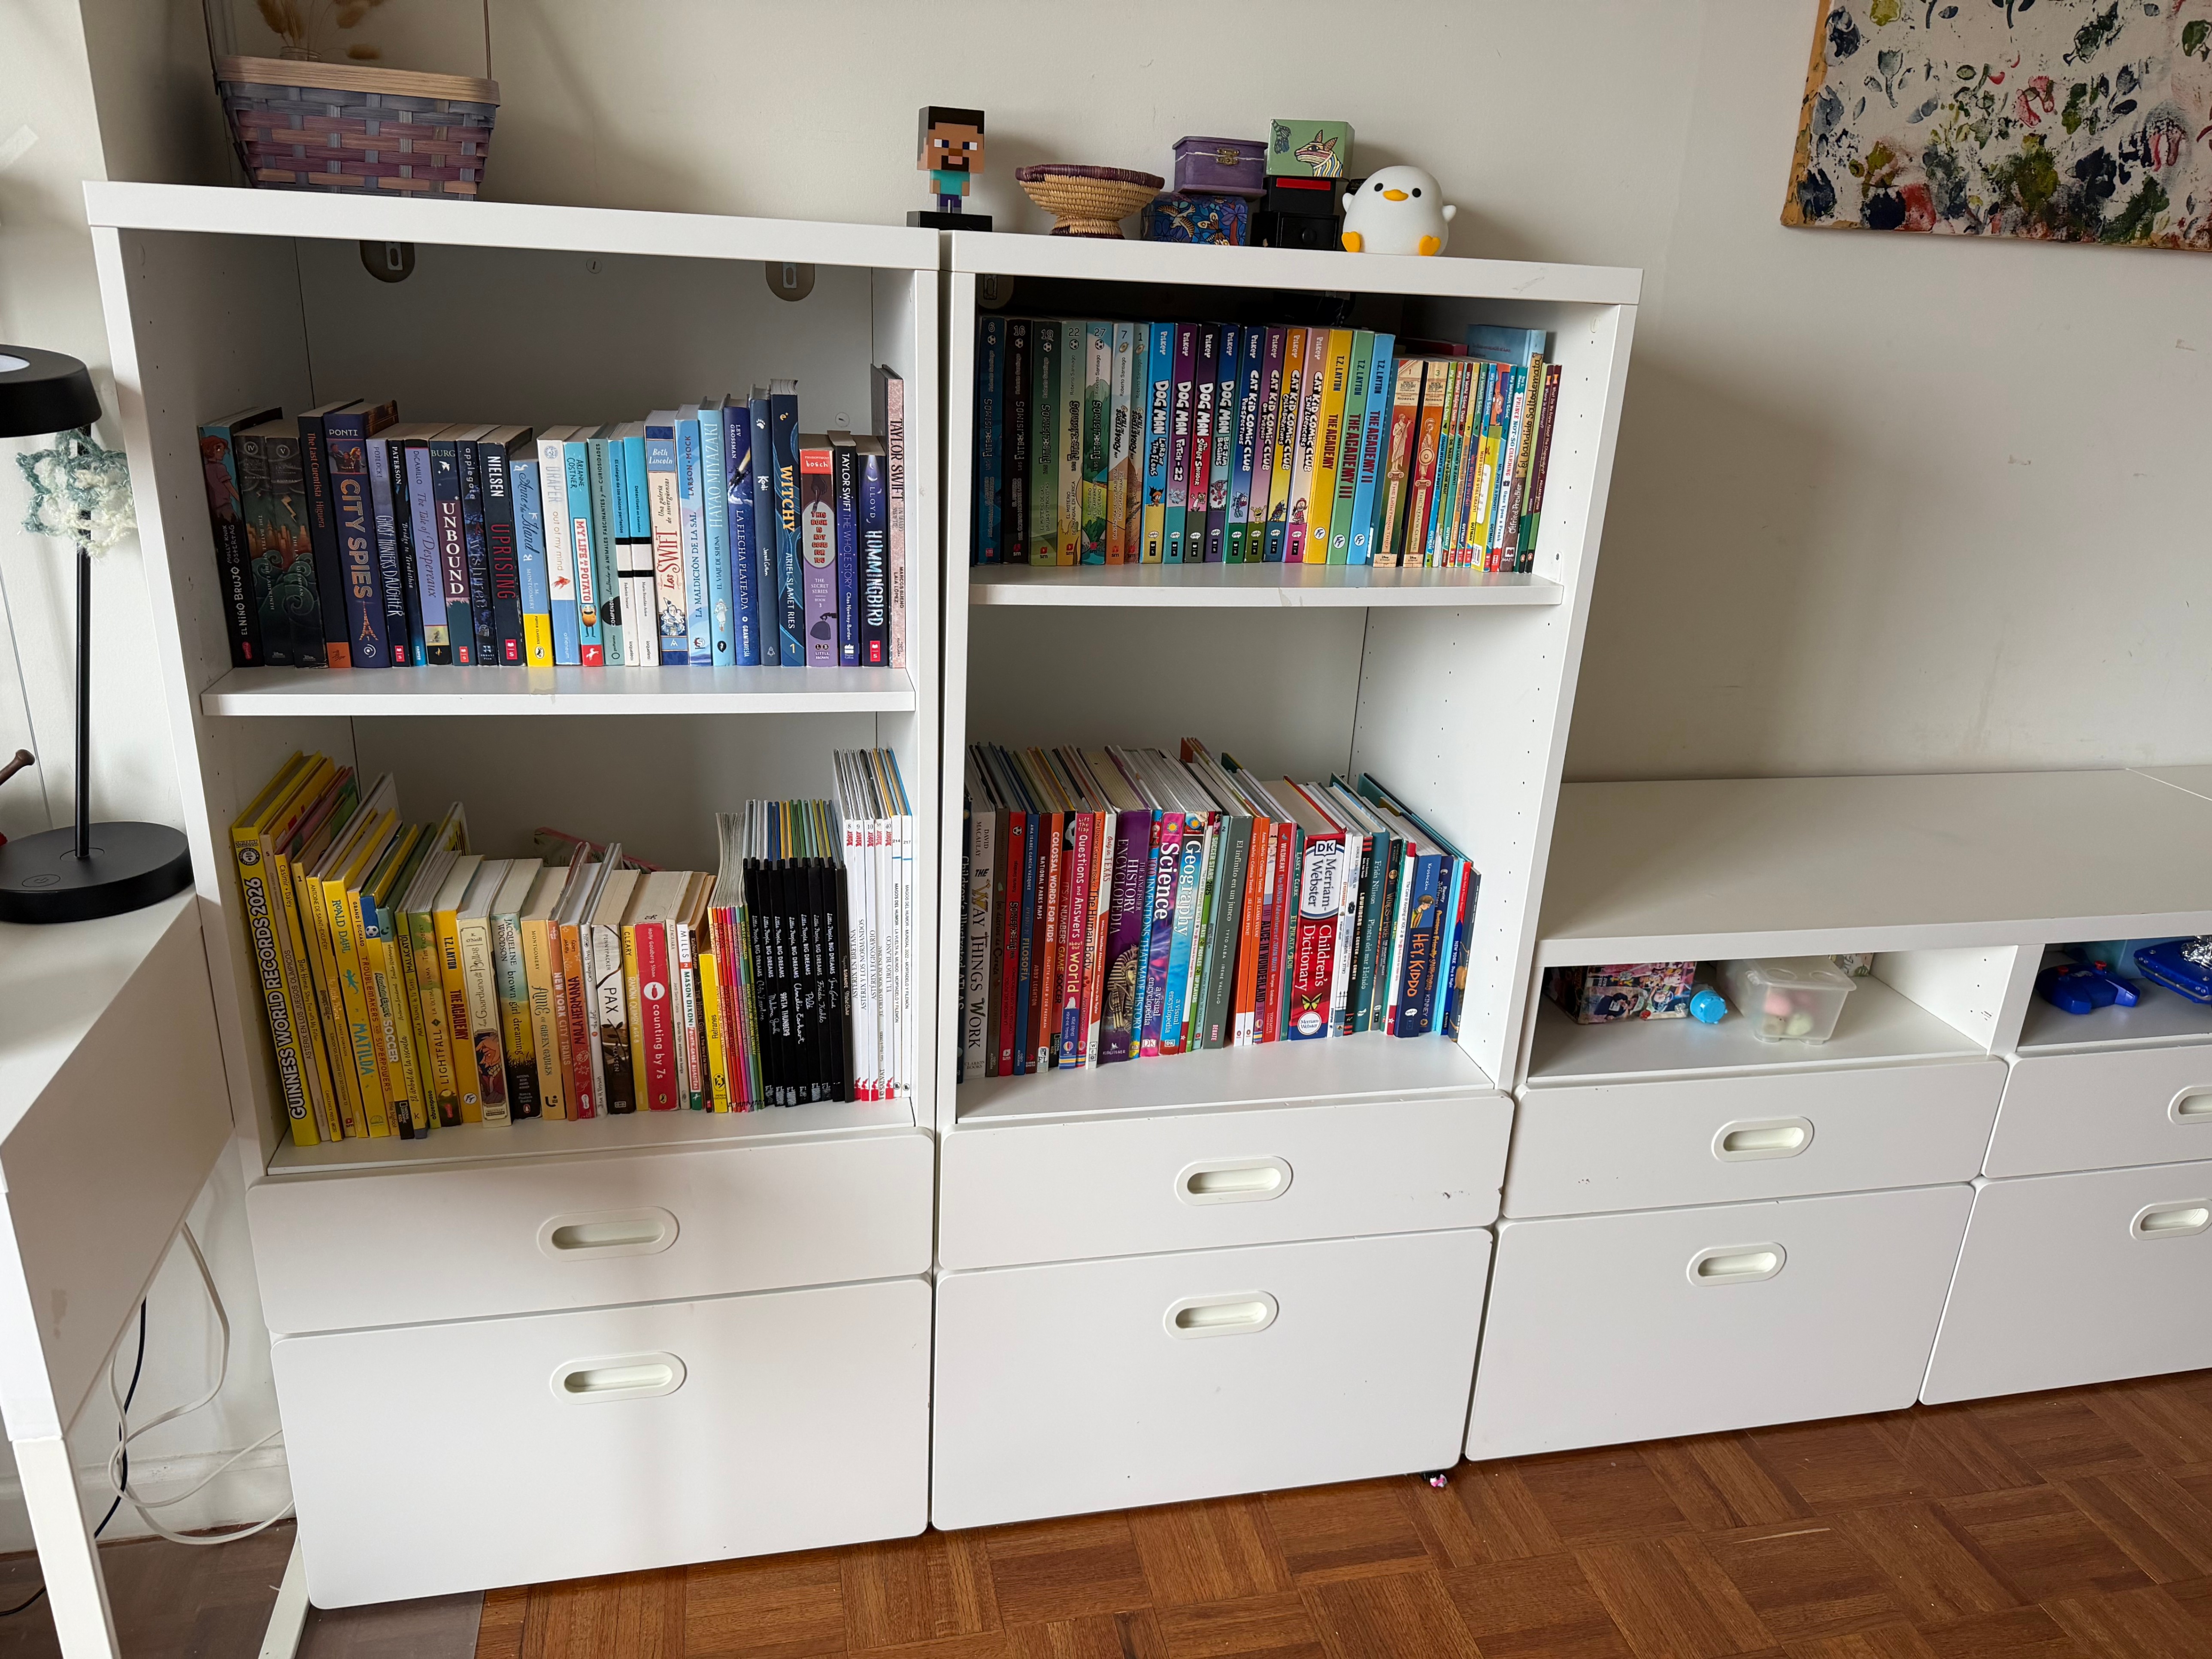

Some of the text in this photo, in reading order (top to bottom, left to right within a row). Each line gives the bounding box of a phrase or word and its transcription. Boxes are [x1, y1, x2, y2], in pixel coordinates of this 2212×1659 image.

[1069, 328, 1080, 337] 22
[1094, 328, 1106, 337] 27
[1270, 370, 1280, 390] CAT
[1333, 368, 1343, 391] LAYTON
[1526, 357, 1542, 419] Saltodemata
[1153, 380, 1169, 434] DOG MAN
[1197, 383, 1213, 436] DOG MAN
[649, 456, 673, 464] Lincoln
[653, 448, 668, 456] Beth
[890, 419, 904, 502] TAYLOR SWIFT
[1262, 446, 1271, 470] CLUB
[1338, 414, 1361, 499] THE ACADEMY III
[1521, 420, 1532, 458] Bandido
[307, 432, 325, 528] The Last Cuentista Higuera
[373, 447, 382, 478] POBLOCKI
[392, 447, 402, 485] PATERSON
[487, 456, 504, 497] NIELSEN
[704, 424, 722, 528] HAYAO MIYAZAKI
[758, 476, 769, 491] Kodi
[842, 453, 850, 488] TAYLOR
[780, 465, 795, 532] WITCHY
[842, 488, 851, 511] SWIFT
[1387, 497, 1395, 530] LIGHTNING
[340, 479, 373, 598] CITY SPIES
[442, 503, 464, 594] UNBOUND
[691, 529, 697, 541] LA
[692, 543, 698, 554] DE
[491, 524, 515, 599] UPRISING
[693, 557, 702, 605] MALDICIÓN
[736, 510, 748, 610] LA FLECHA PLATEADA
[865, 531, 884, 626] HUMMINGBIRD
[230, 566, 248, 635] EL NIÑO BRUJO
[696, 609, 702, 618] LA
[1051, 831, 1059, 873] COLOSSAL
[1076, 835, 1088, 883] Questions
[1233, 849, 1241, 877] infinito
[1317, 843, 1334, 852] DK
[244, 877, 268, 916] 2026
[280, 865, 290, 886] Casimir
[1110, 839, 1129, 934] ENCYCLOPEDIA
[1124, 859, 1139, 913] HISTORY
[1154, 842, 1180, 919] Science
[1174, 840, 1201, 936] Geography
[1229, 890, 1235, 900] un
[1231, 879, 1237, 888] en
[1309, 859, 1323, 907] Webster
[1322, 858, 1336, 911] Merriam-
[1370, 861, 1382, 904] Frida Nilsson
[332, 900, 351, 953] ROALD DAHL
[1072, 898, 1084, 938] Answers
[252, 917, 283, 990] RECORDS
[497, 924, 508, 961] WOODSON
[504, 919, 517, 966] JACQUELINE
[680, 930, 689, 958] MILLS
[1021, 938, 1029, 981] FILOSOFÍA
[1295, 925, 1315, 991] Dictionary
[1315, 925, 1332, 986] Children's
[684, 971, 692, 998] MASON
[1067, 952, 1080, 993] World
[1407, 934, 1429, 997] HEY, KIDDO
[268, 991, 293, 1048] WORLD
[507, 971, 524, 1055] brown girl dreaming
[603, 988, 619, 1014] PAX
[806, 992, 814, 1010] Pelé
[383, 1020, 399, 1063] SOCCER
[653, 1004, 666, 1079] counting by 7s
[782, 1010, 790, 1036] THUNBERG
[352, 1023, 375, 1075] MATILDA
[433, 1029, 449, 1085] LIGHTFALL
[279, 1048, 306, 1119] GUINNESS
